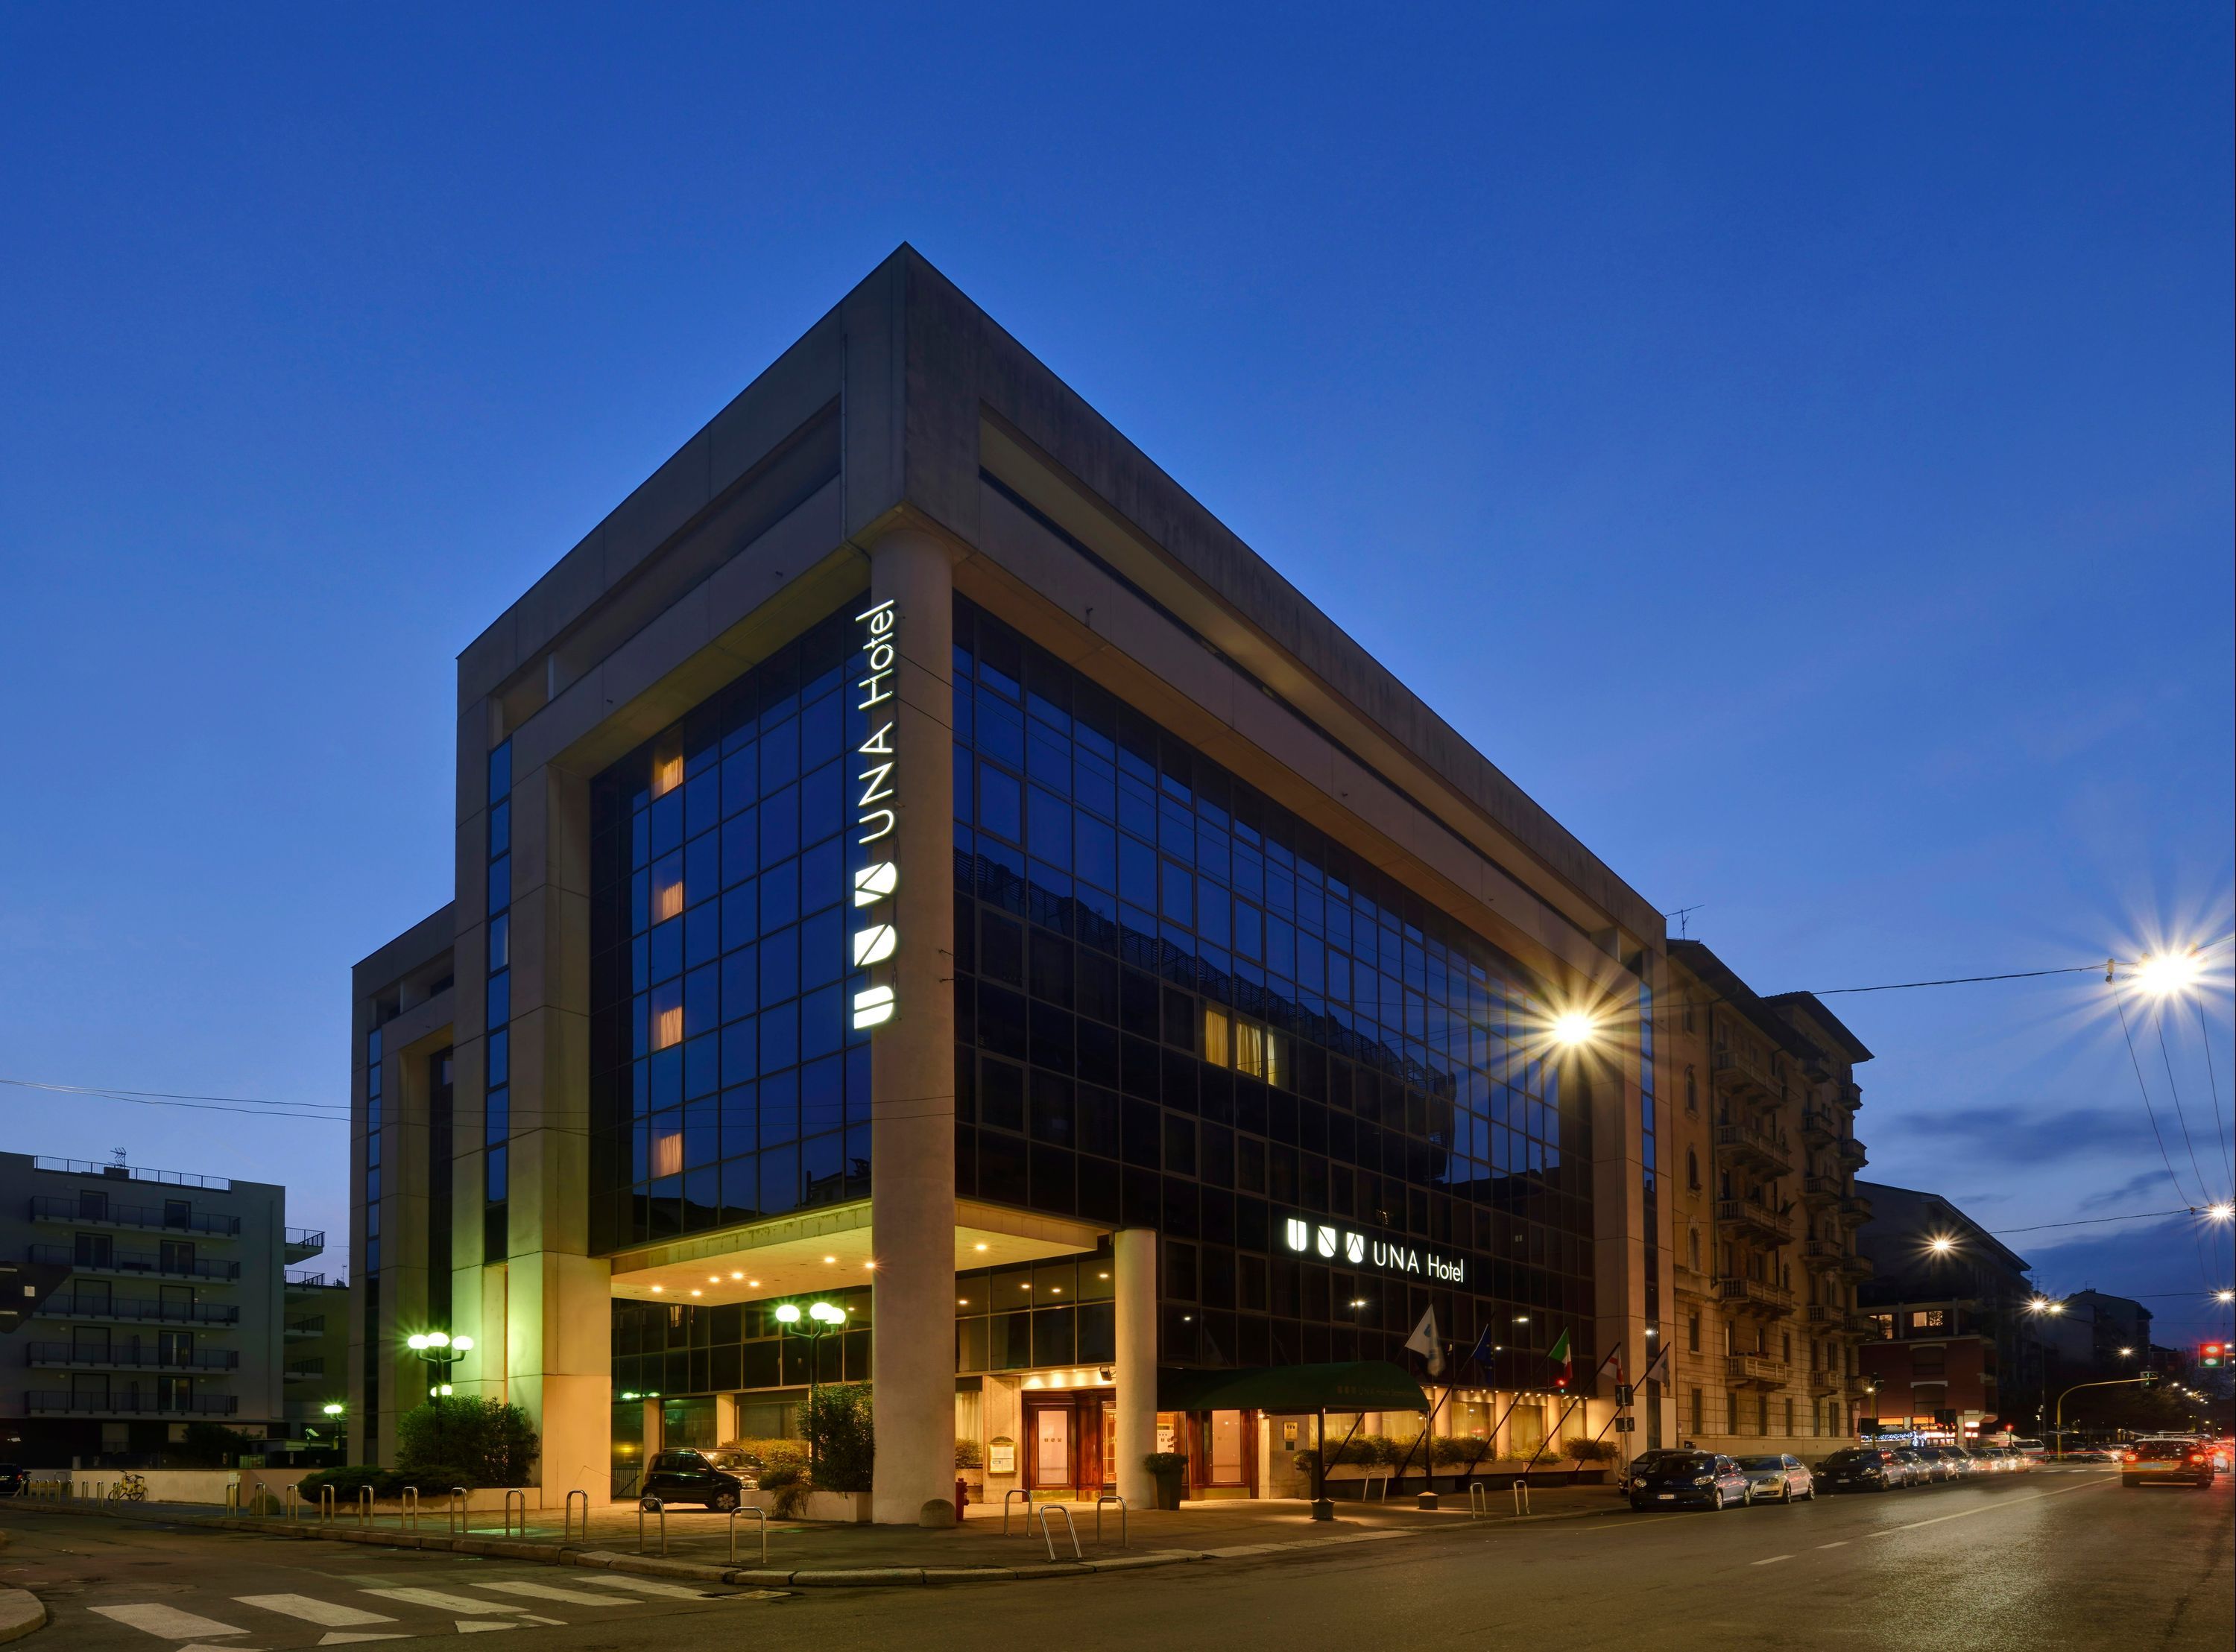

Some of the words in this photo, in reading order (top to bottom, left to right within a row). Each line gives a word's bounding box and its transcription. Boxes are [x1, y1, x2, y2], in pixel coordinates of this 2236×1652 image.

[855, 599, 894, 709] Hotel
[858, 721, 894, 844] UNA
[1374, 1241, 1420, 1274] UNA
[1428, 1253, 1464, 1283] Hotel
